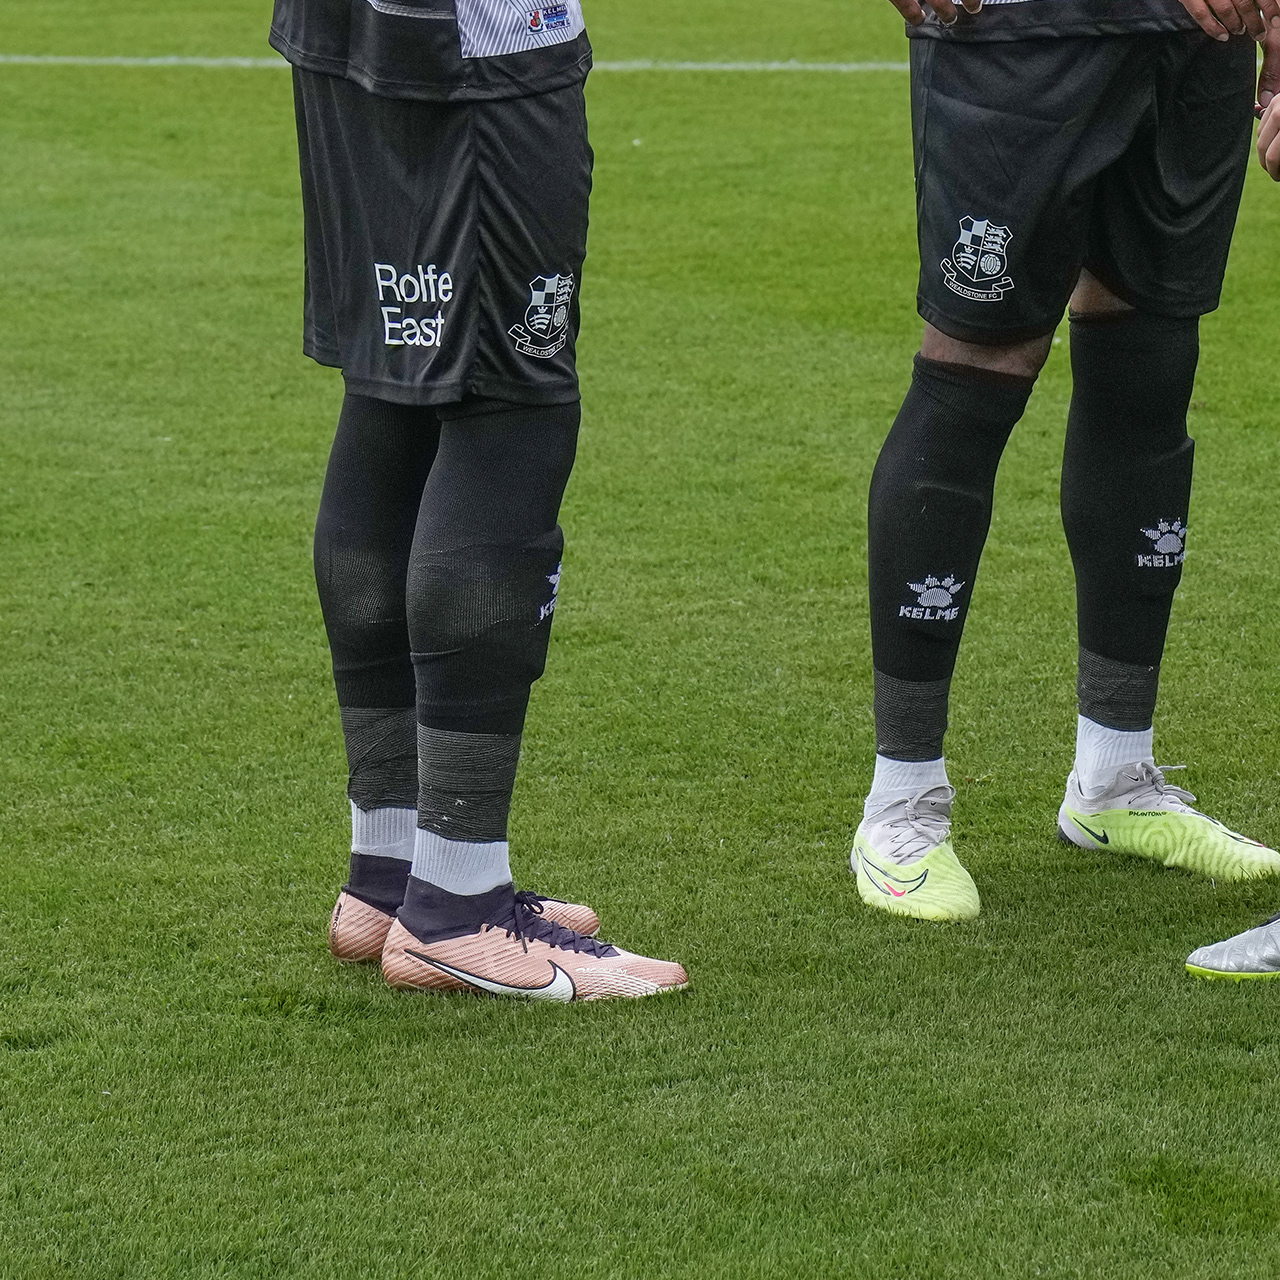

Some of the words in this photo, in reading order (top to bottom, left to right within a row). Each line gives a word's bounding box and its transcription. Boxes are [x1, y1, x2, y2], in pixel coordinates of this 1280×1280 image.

[374, 263, 453, 303] Rolfe
[949, 281, 987, 300] WEALDSTONE
[381, 306, 444, 347] East
[899, 606, 960, 622] KELME
